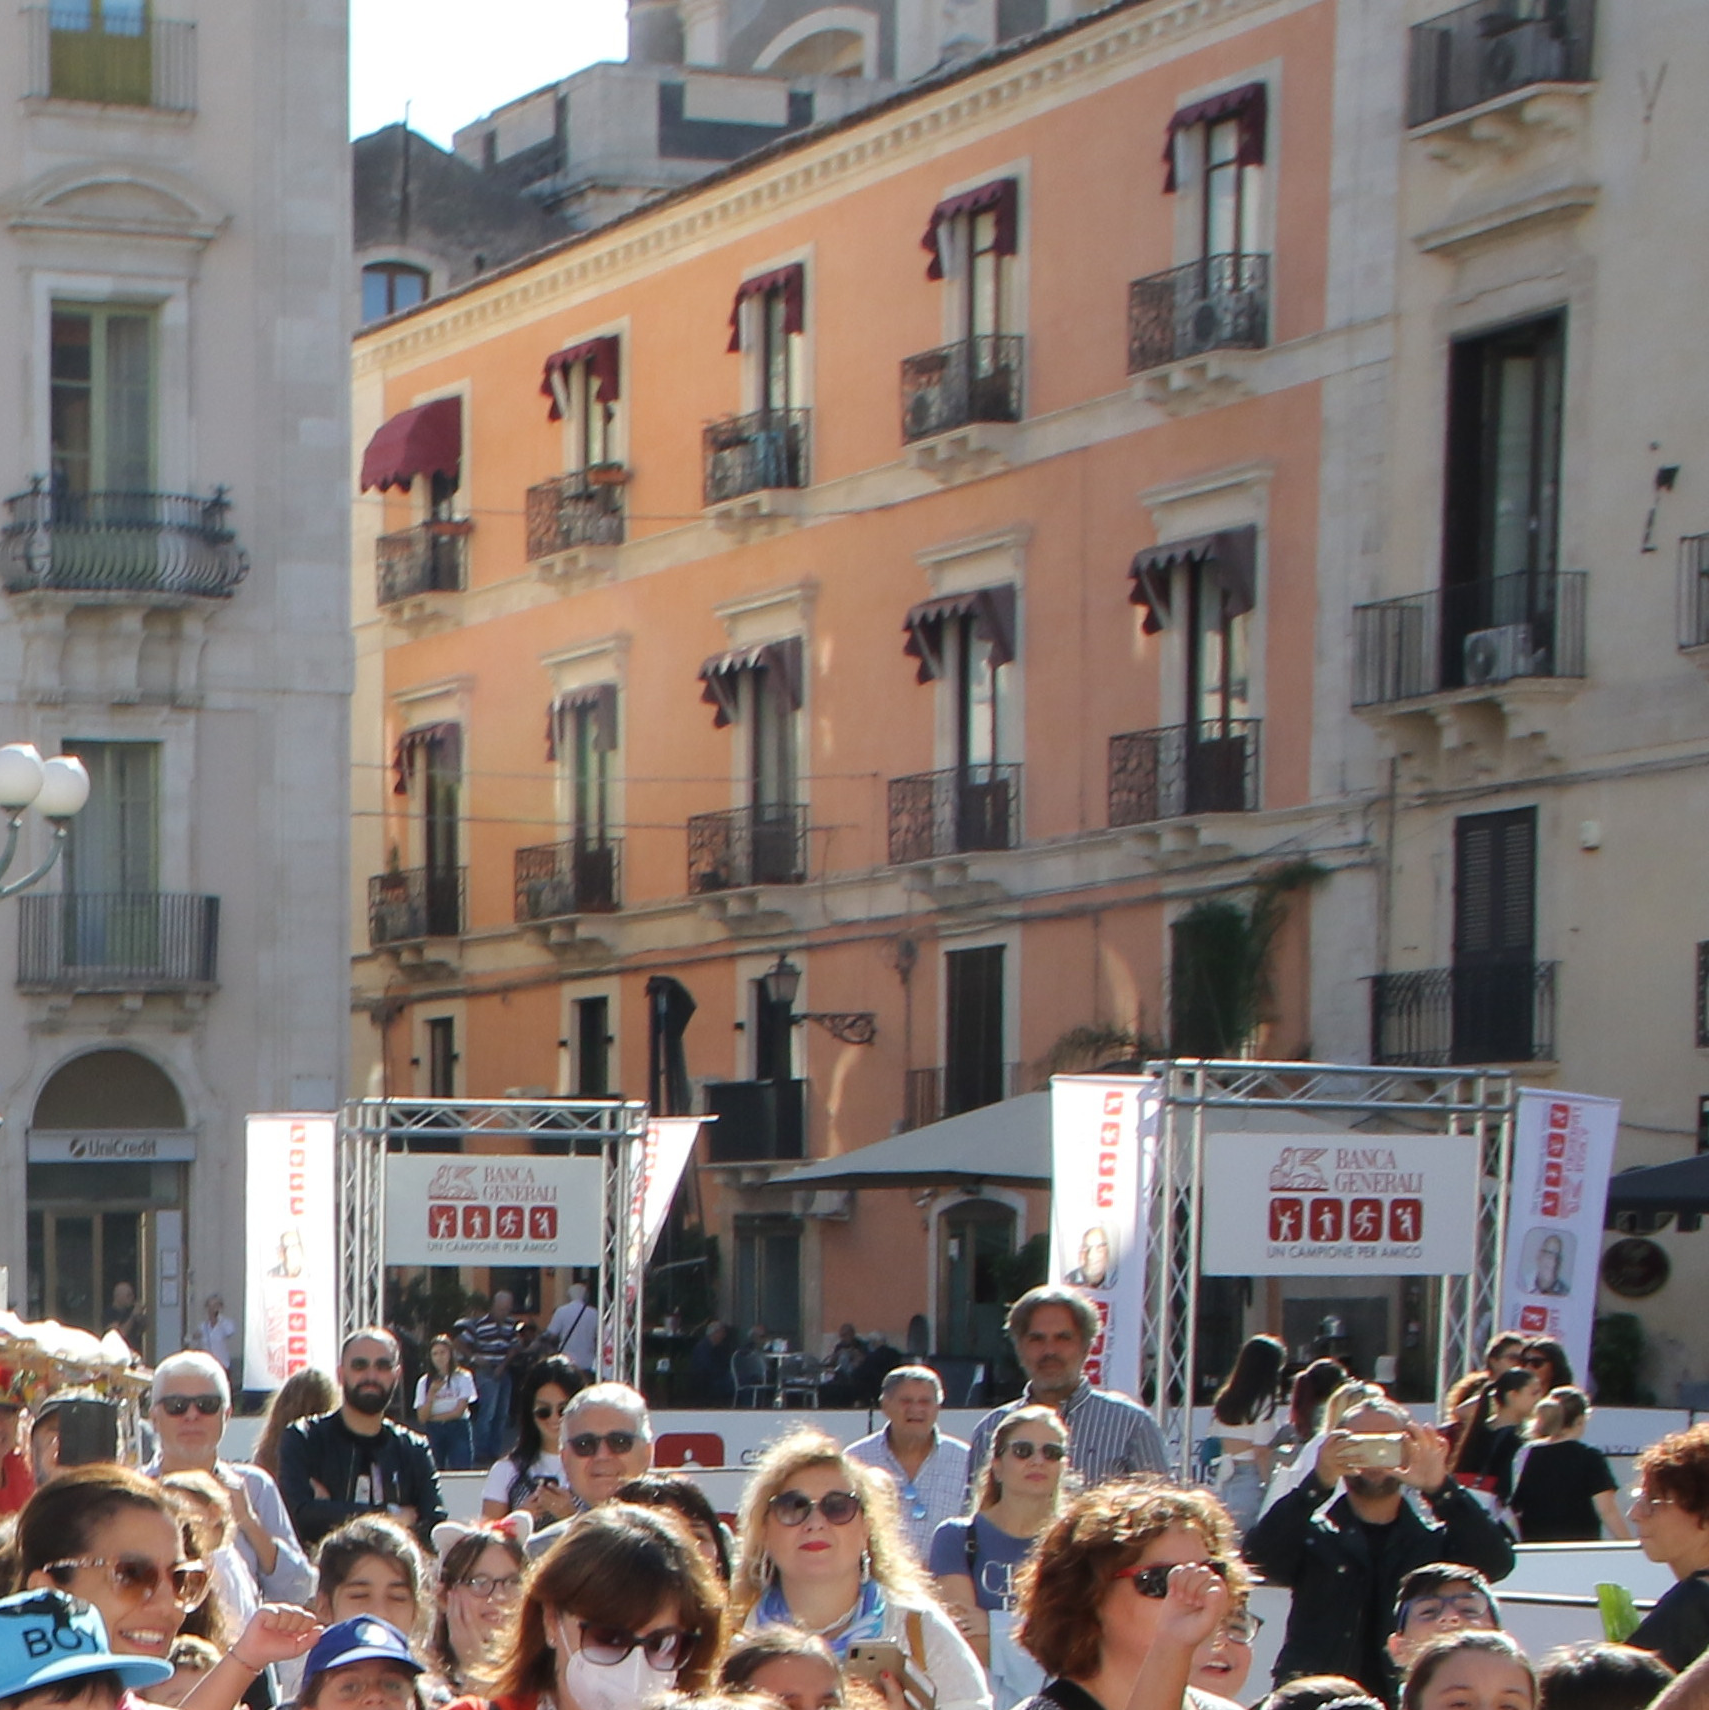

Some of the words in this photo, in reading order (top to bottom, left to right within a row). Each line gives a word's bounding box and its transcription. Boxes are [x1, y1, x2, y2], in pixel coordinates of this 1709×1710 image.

[89, 1138, 156, 1157] UniCredit
[1335, 1148, 1397, 1170] BANCA
[484, 1166, 535, 1184] BANCA
[1334, 1172, 1424, 1194] GENERALI
[483, 1184, 558, 1202] GENERALI
[1267, 1246, 1287, 1259] UN
[1289, 1246, 1354, 1259] CAMPIONE
[1358, 1246, 1377, 1259] PER
[1381, 1246, 1422, 1259] AMICO
[22, 1627, 99, 1658] BOY
